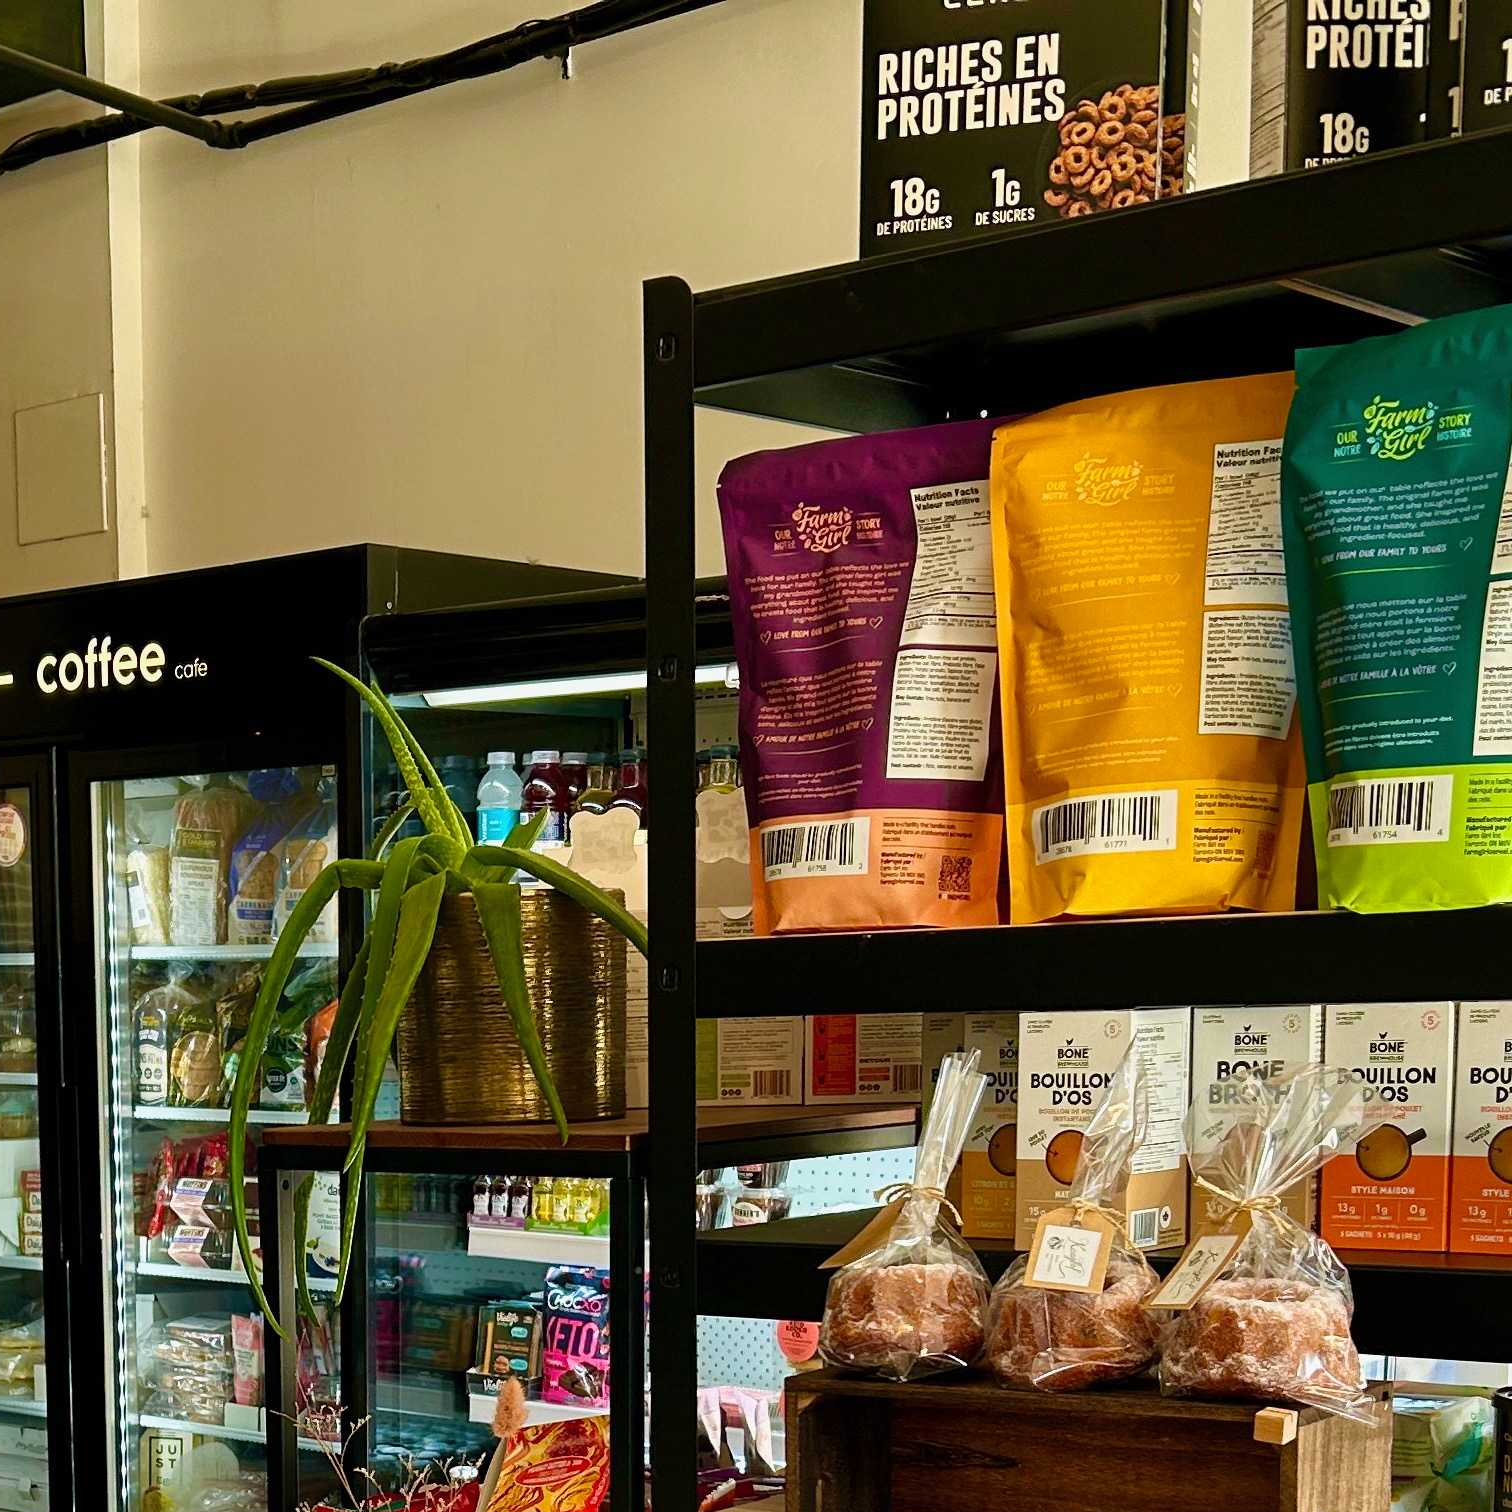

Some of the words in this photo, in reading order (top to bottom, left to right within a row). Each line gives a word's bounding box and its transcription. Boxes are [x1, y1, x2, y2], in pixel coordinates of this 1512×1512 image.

[879, 40, 1003, 96] RICHES
[1015, 32, 1060, 79] EN
[877, 78, 1066, 141] PROTÉINES
[1320, 113, 1370, 154] 18G
[890, 177, 940, 218] 18G
[991, 168, 1021, 207] 1G
[877, 222, 891, 236] DE
[893, 214, 953, 235] PROTÉINES
[975, 212, 990, 225] DE
[993, 207, 1036, 223] SUCRES
[1365, 400, 1426, 435] Farm
[1439, 413, 1472, 429] STORY
[1337, 430, 1358, 445] OUR
[1378, 425, 1433, 460] Girl
[1077, 458, 1132, 483] Farm
[1088, 476, 1136, 506] Girl
[798, 506, 844, 532] Farm
[856, 517, 881, 530] STORY
[775, 529, 792, 541] OUR
[811, 526, 852, 553] Girl
[36, 635, 168, 695] coffee
[174, 657, 208, 681] cafe
[1400, 666, 1410, 676] LA
[1235, 1034, 1270, 1046] BONE
[1369, 1042, 1404, 1053] BONE
[1057, 1048, 1088, 1059] BONE
[1052, 1089, 1092, 1106] D'OS
[1351, 1186, 1377, 1194] STYLE
[1379, 1186, 1415, 1195] MAISON
[1482, 1189, 1510, 1197] STYLE
